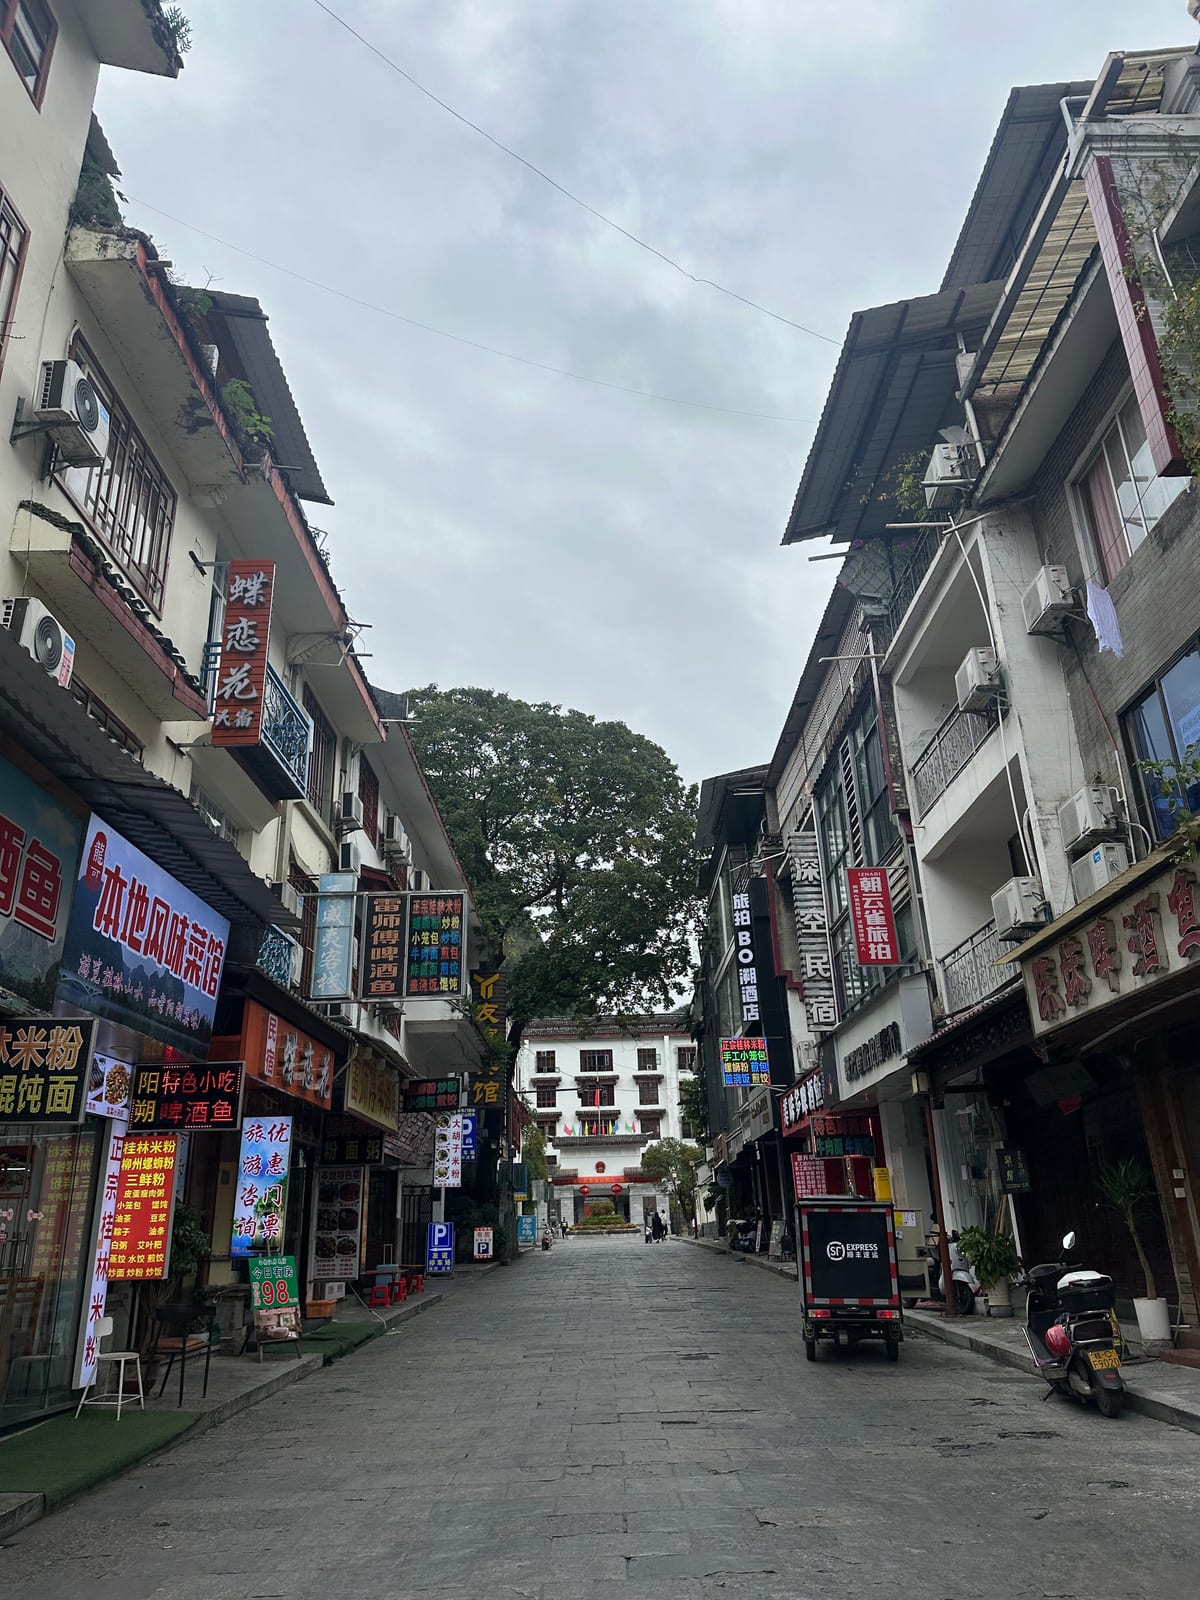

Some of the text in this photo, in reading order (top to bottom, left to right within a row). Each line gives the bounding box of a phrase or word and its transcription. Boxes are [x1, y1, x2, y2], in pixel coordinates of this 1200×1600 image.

[216, 571, 271, 700] 蝶恋花
[411, 899, 461, 914] 正宗桂林米粉
[441, 915, 459, 929] 炒粉
[859, 877, 893, 960] 朝云雀旅拍
[94, 864, 225, 998] 本地风味菜馆
[411, 931, 439, 945] 小笼包
[368, 898, 402, 995] 雷师傅啤酒鱼
[795, 857, 837, 1025] 深空民宿
[410, 947, 439, 961] 牛肉面
[264, 1014, 277, 1075] 民宿
[722, 1039, 765, 1050] 正宗桂林米粉
[723, 1050, 766, 1061] 手工小笼包
[162, 1070, 236, 1095] 特色小吃
[160, 1100, 234, 1124] 啤酒鱼
[122, 1140, 177, 1154] 桂林米粉
[452, 1119, 461, 1179] 大胡子米粉
[121, 1157, 175, 1171] 柳州螺蛳粉
[125, 1173, 166, 1187] 三鲜粉
[116, 1201, 142, 1210] 小笼包
[115, 1213, 167, 1223] 油茶 豆浆
[148, 1227, 166, 1236] 油条
[434, 1224, 447, 1246] P
[111, 1242, 128, 1250] 白粥
[479, 1243, 488, 1254] P
[846, 1243, 878, 1251] EXPRESS
[128, 1254, 145, 1263] 水饺
[846, 1251, 879, 1259] 顺丰速运
[108, 1268, 125, 1278] 炒面
[126, 1267, 143, 1277] 炒粉
[253, 1265, 293, 1279] 今日有房
[262, 1280, 289, 1305] 98
